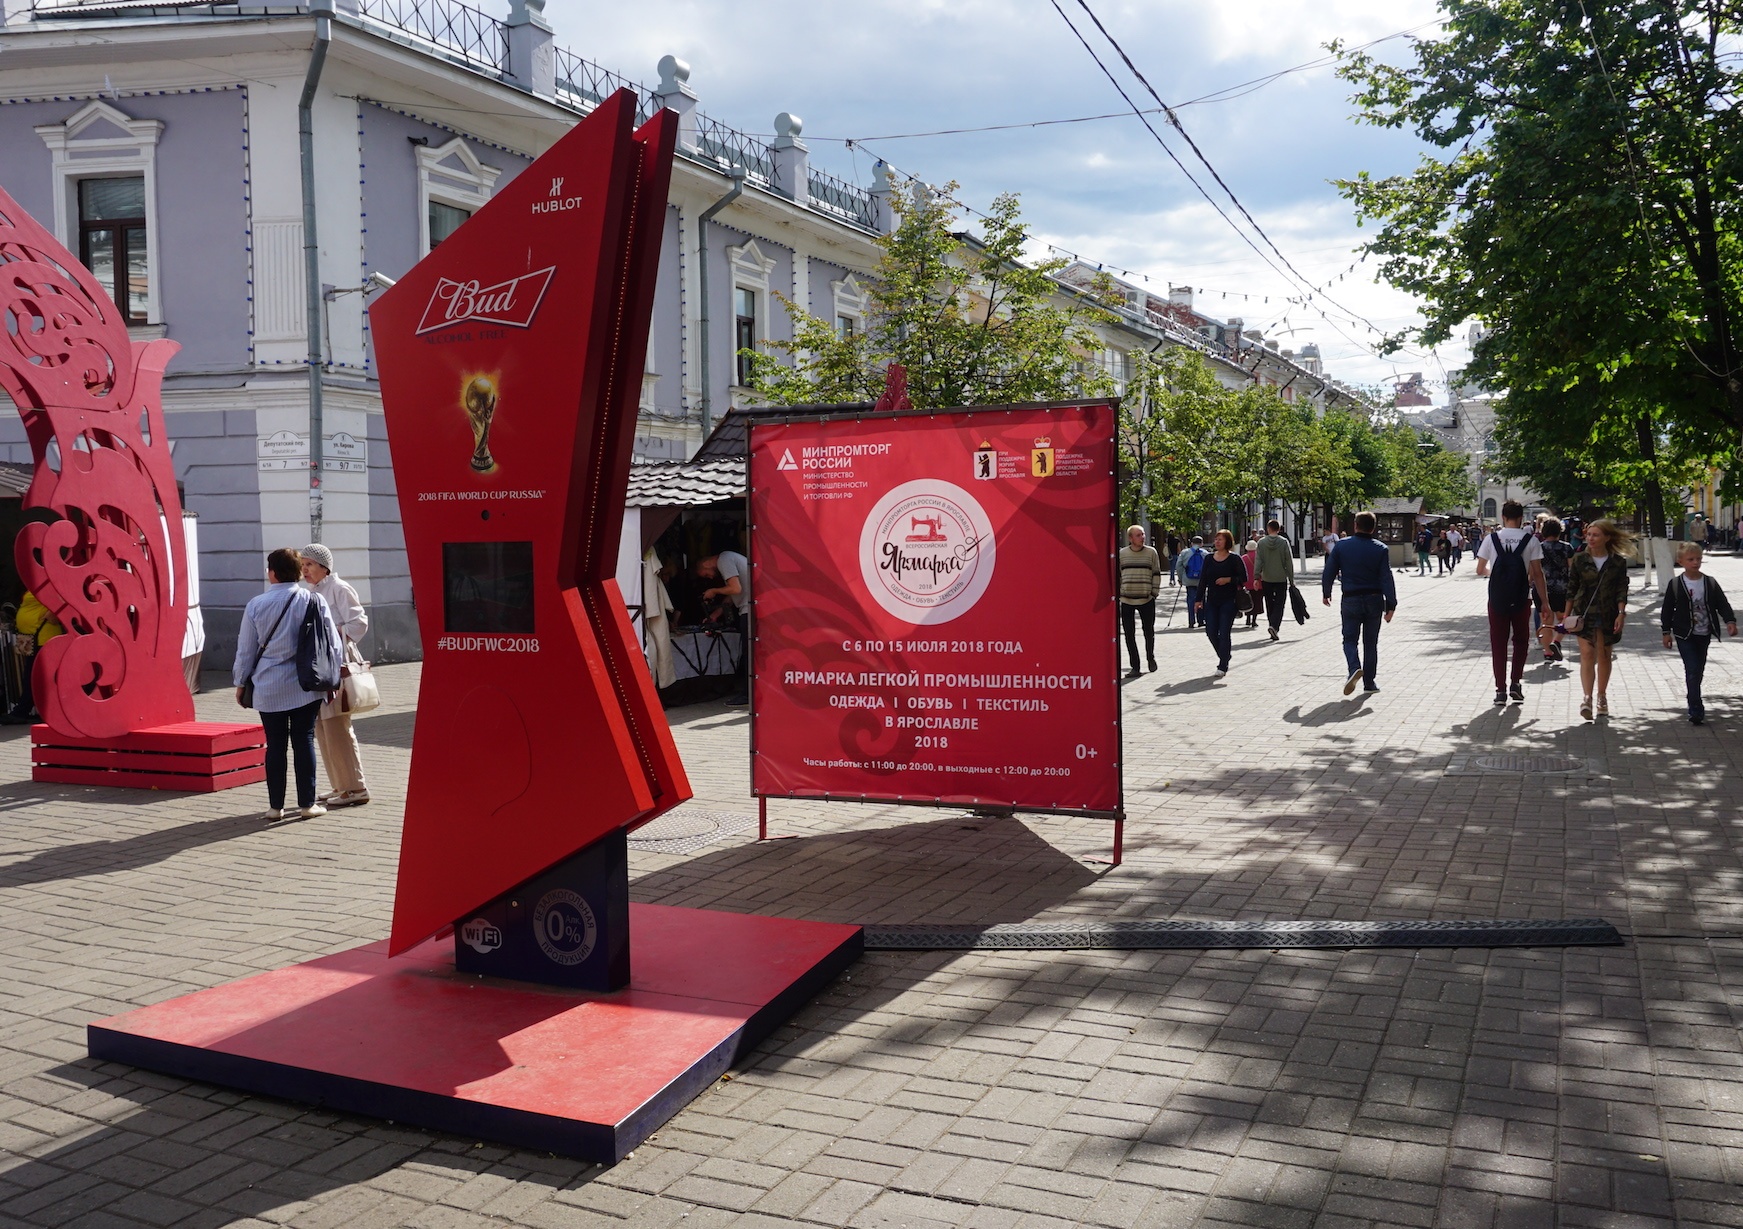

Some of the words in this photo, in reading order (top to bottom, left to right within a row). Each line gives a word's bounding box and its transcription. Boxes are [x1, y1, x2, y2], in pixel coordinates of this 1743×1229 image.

[532, 197, 582, 214] HUBLOT
[438, 278, 516, 320] Bud
[424, 332, 474, 345] ALCOHOL
[480, 329, 508, 341] FREE
[802, 444, 892, 458] МИНПРОМТОРГ
[339, 462, 349, 470] 9/7
[803, 457, 852, 470] РОССИИ
[803, 472, 854, 480] МИНИСТЕРСТВО
[803, 482, 868, 490] ПРОМЫШЛЕННОСТИ
[418, 492, 437, 501] 2018
[438, 492, 456, 501] FIFA
[457, 491, 488, 500] WORLD
[489, 490, 508, 500] CUP
[882, 501, 917, 534] МИНПРОМТОРГА
[946, 505, 970, 532] ЯРОСЛАВЛЕ
[881, 542, 964, 585] Ярмарка
[890, 583, 911, 601] ОДЕЖДА
[938, 581, 964, 601] ТЕКСТИЛЬ
[438, 637, 540, 652] #BUDFWC2018
[842, 641, 851, 652] С
[854, 641, 862, 652] 6
[866, 641, 884, 652] ПО
[889, 641, 903, 652] 15
[907, 641, 947, 652] ИЮЛЯ
[951, 641, 984, 652] 2018
[988, 641, 1023, 654] ГОДА
[784, 671, 855, 685] ЯРМАРКА
[858, 670, 919, 687] ЛЕГКОЙ
[924, 673, 1092, 689] ПРОМЫШЛЕННОСТИ
[829, 695, 885, 709] ОДЕЖДА
[907, 697, 953, 710] ОБУВЬ
[976, 698, 1049, 712] ТЕКСТИЛЬ
[885, 716, 893, 727] В
[897, 716, 979, 730] ЯРОСЛАВЛЕ
[915, 736, 948, 748] 2018
[1075, 744, 1097, 759] 0+
[803, 757, 826, 767] Часы
[828, 759, 862, 768] работы:
[871, 761, 894, 769] 11:00
[945, 765, 993, 774] выходные
[1004, 766, 1028, 775] 12:00
[1044, 767, 1070, 776] 20:00
[534, 890, 595, 928] БЕЗАЛКОГОЛЬНАЯ
[565, 915, 581, 925] Алк.
[541, 942, 591, 965] ПРОДУКЦИЯ
